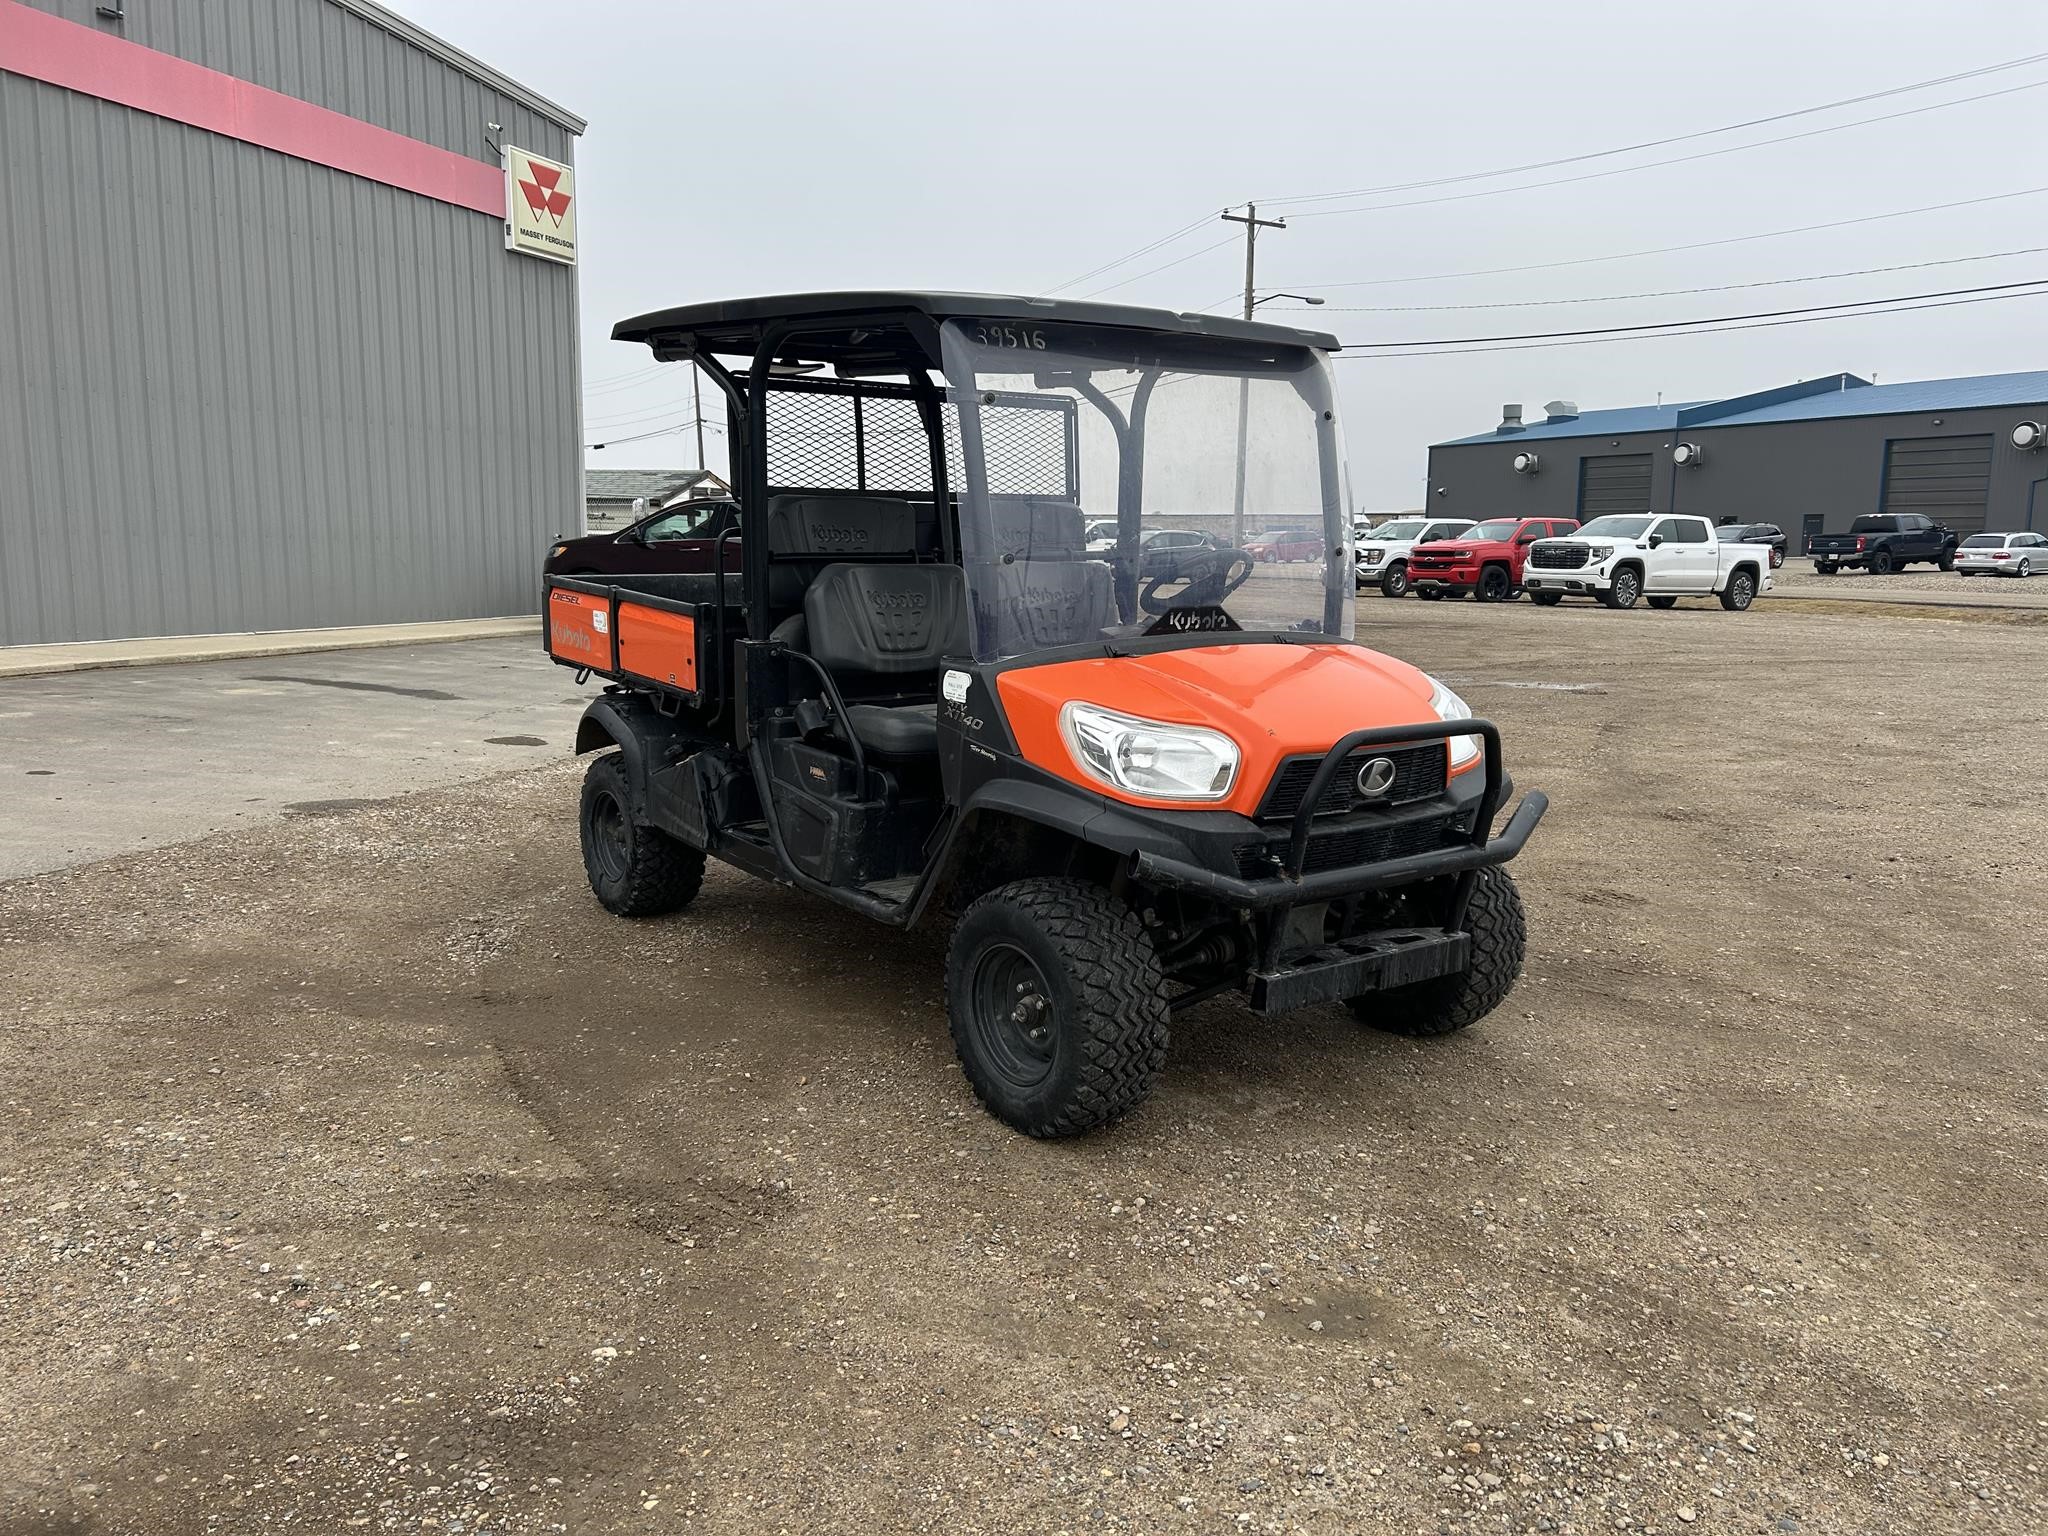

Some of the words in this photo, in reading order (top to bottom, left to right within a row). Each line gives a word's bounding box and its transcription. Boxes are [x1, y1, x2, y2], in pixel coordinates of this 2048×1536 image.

[520, 228, 544, 240] MASSEY
[545, 235, 574, 249] FERGUSON
[977, 326, 1045, 350] 39516
[811, 524, 868, 543] Kubota
[552, 592, 580, 605] DIESEL
[866, 590, 927, 609] Kubota
[1170, 610, 1229, 630] Kubota
[553, 620, 591, 652] Kubota
